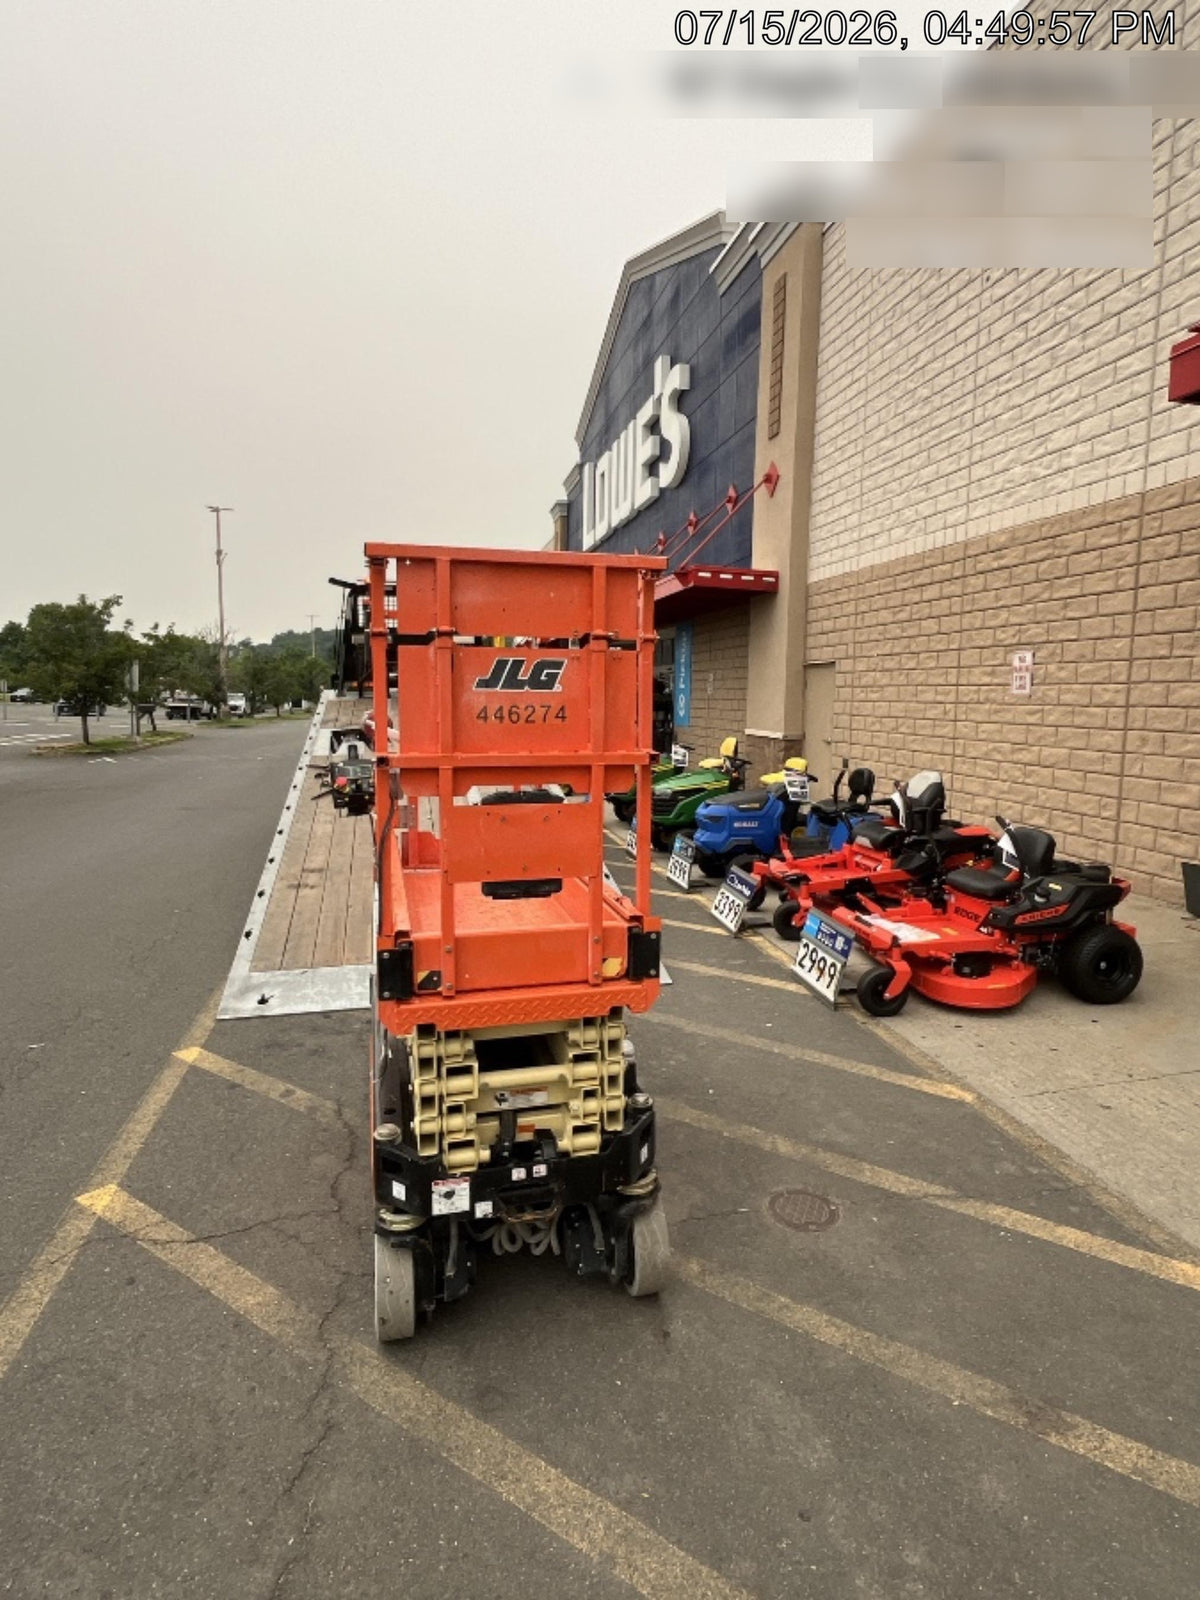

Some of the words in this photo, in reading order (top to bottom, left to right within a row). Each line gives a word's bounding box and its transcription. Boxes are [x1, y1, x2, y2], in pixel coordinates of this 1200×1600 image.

[582, 354, 691, 551] LOWE'S
[472, 657, 567, 692] JLG
[476, 705, 567, 723] 446274
[798, 943, 837, 989] 2999
